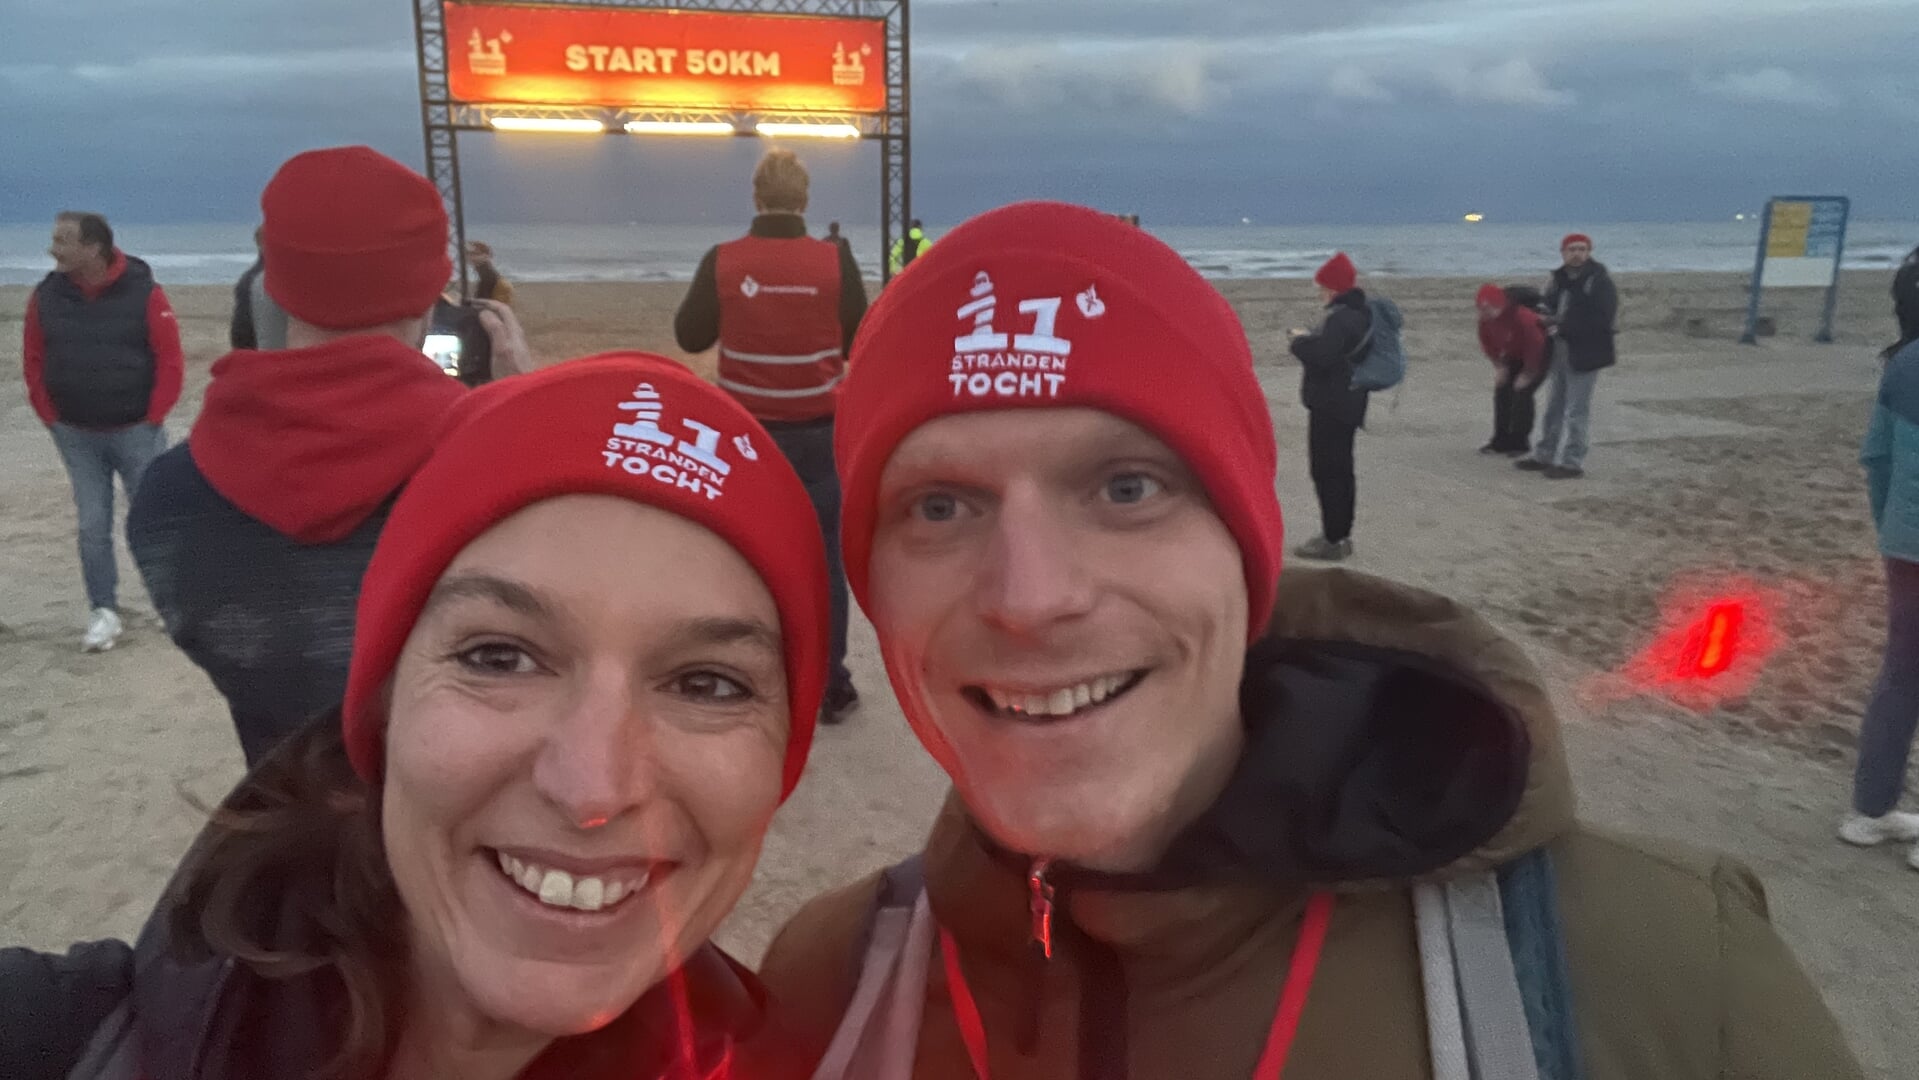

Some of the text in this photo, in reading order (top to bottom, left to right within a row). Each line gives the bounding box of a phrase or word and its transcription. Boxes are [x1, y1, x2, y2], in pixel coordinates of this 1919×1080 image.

[565, 44, 780, 76] START 50KM
[952, 353, 1066, 371] STRANDEN
[949, 372, 1065, 397] TOCHT
[602, 450, 723, 500] TOCHT
[606, 437, 725, 487] STRANDEN
